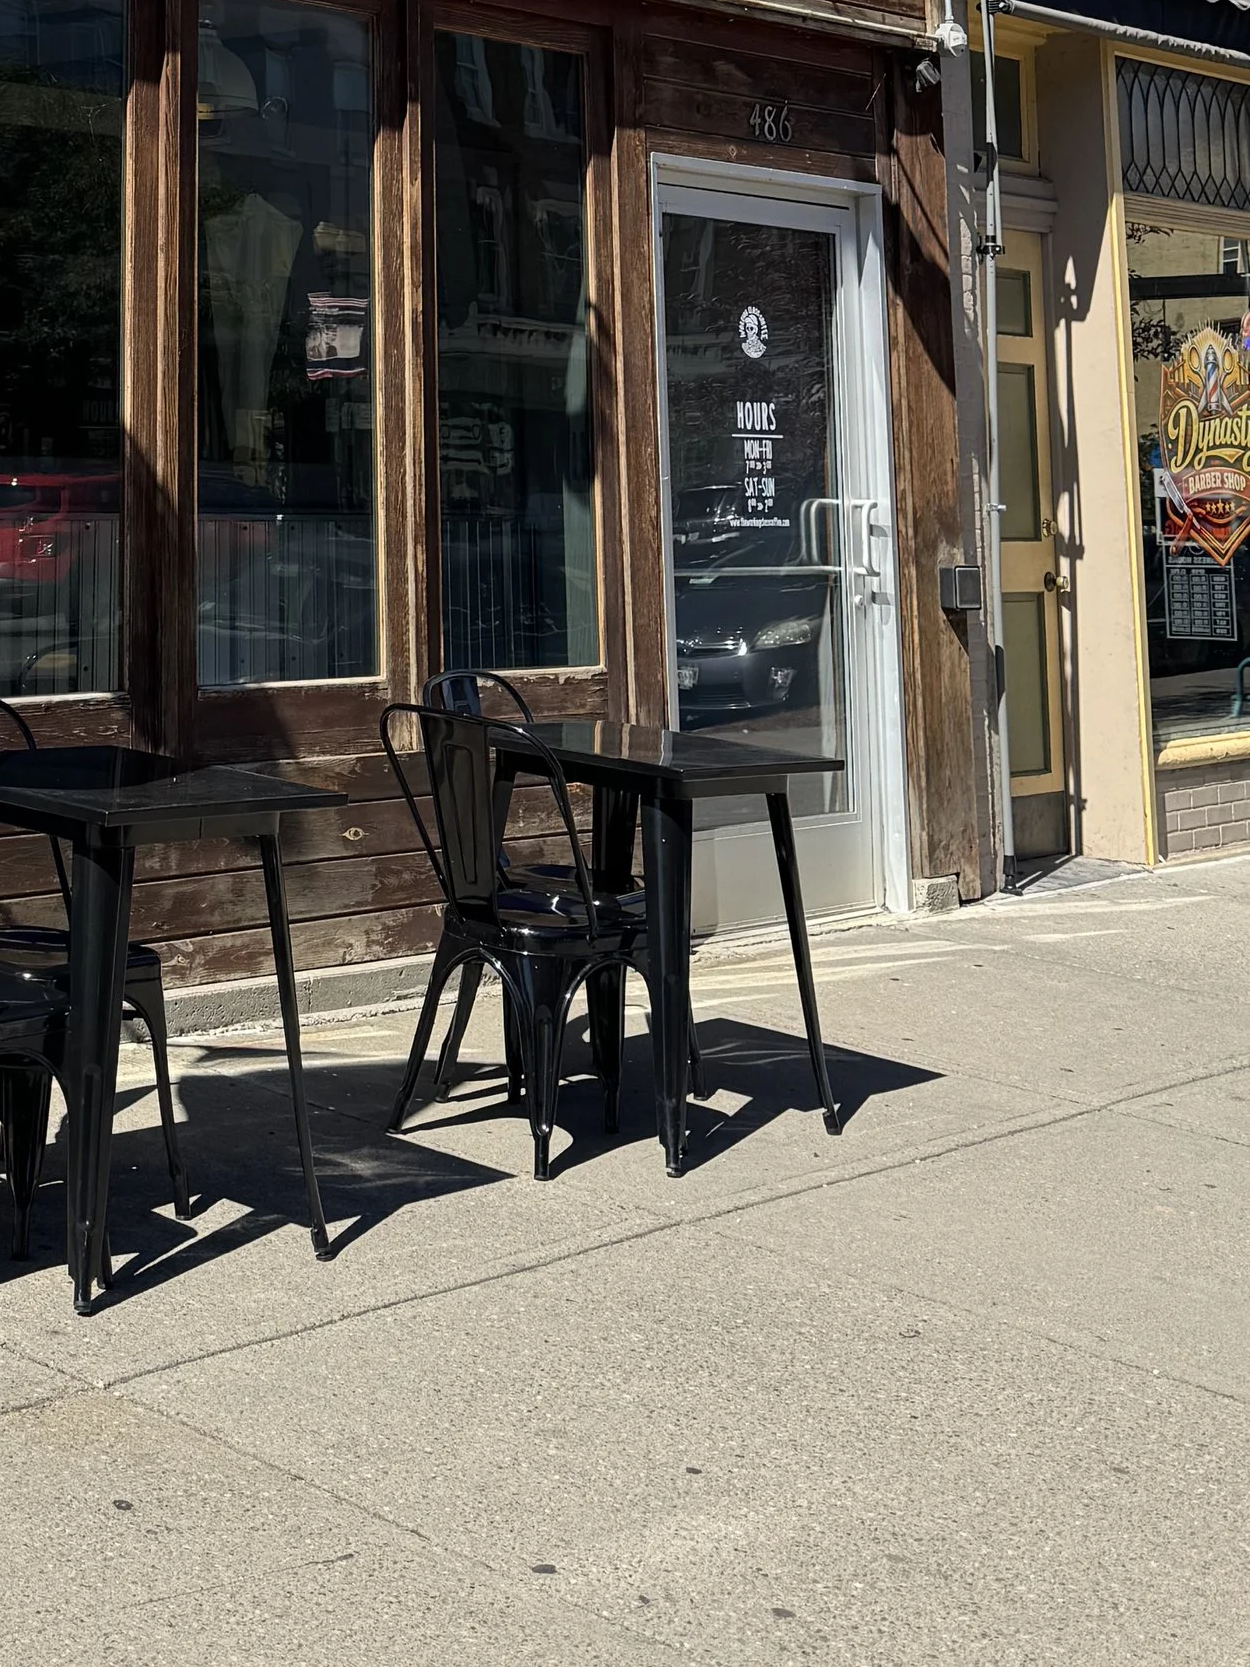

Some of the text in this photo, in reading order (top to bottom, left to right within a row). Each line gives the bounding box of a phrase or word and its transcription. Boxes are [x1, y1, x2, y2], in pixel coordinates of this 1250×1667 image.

[749, 103, 792, 143] 486
[736, 400, 777, 431] HOURS
[744, 477, 775, 497] SAT-SUN
[1188, 472, 1246, 495] BARBER SHOP
